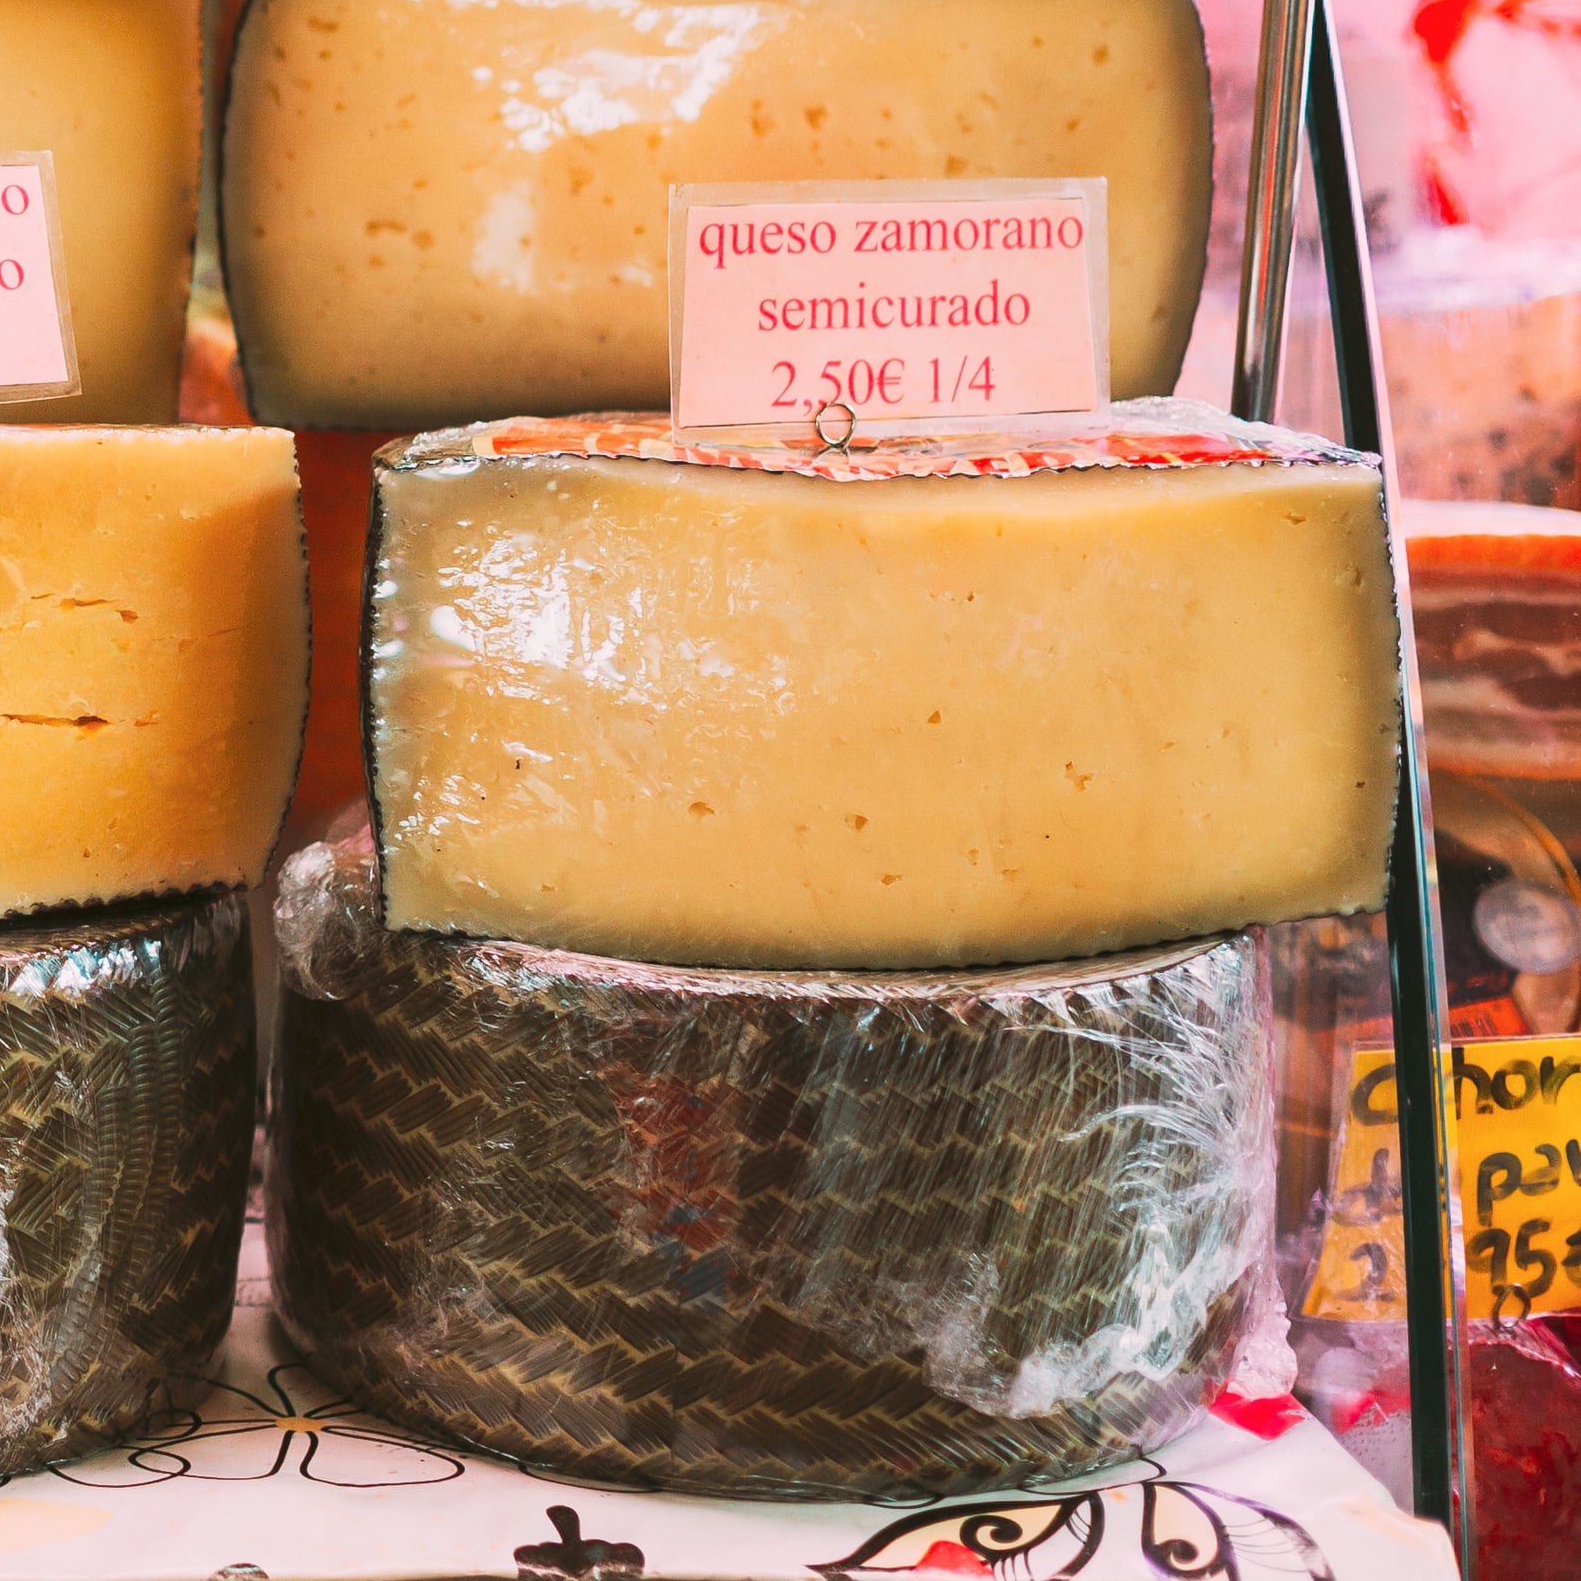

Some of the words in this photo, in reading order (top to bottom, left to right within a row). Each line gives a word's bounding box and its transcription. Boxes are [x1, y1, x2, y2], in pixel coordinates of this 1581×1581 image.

[699, 219, 837, 269] queso
[853, 215, 1084, 254] zamorano
[757, 278, 1031, 332] semicurado
[770, 356, 907, 416] 2,50€
[927, 354, 996, 404] 1/4
